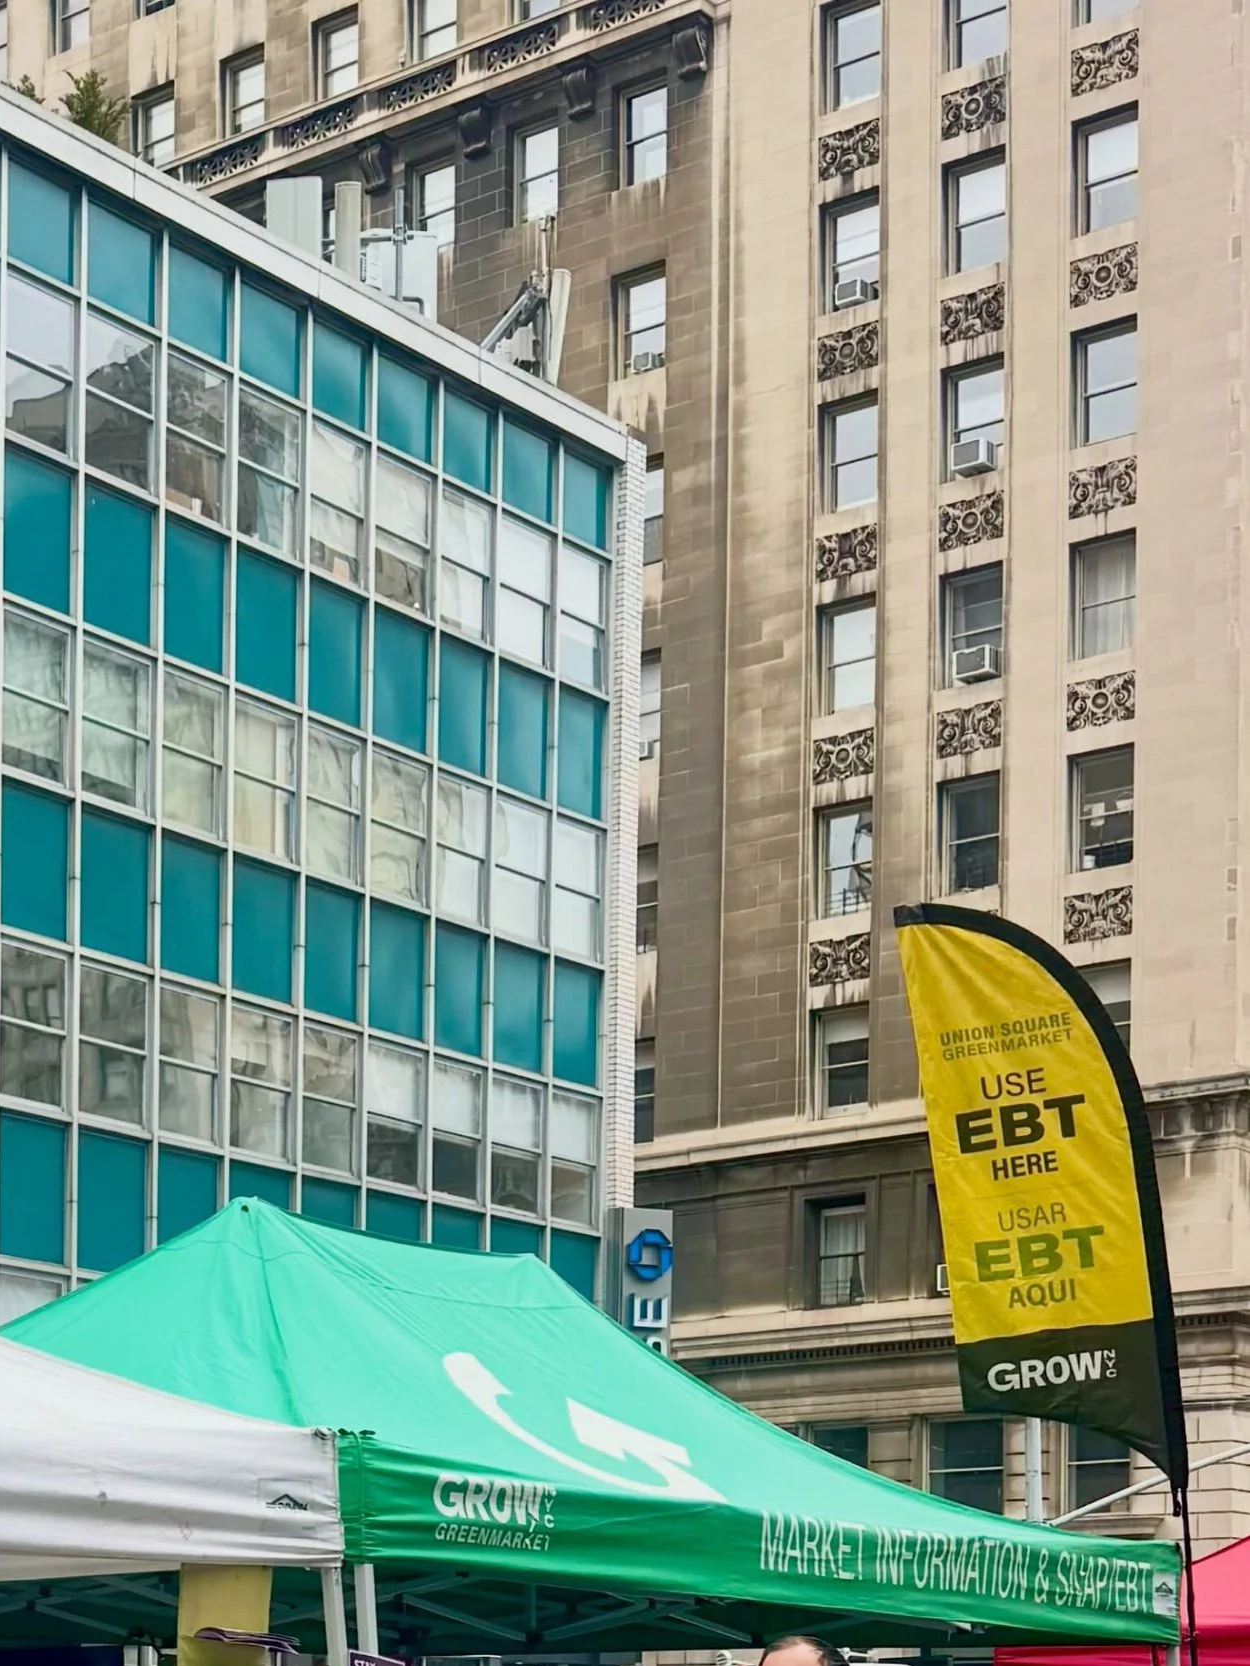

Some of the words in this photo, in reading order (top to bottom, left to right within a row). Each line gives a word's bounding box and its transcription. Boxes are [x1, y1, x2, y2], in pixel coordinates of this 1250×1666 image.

[939, 1026, 997, 1048] UNION
[1000, 1011, 1072, 1041] SQUARE
[942, 1027, 1073, 1062] GREENMARKET
[979, 1067, 1047, 1101] USE
[955, 1094, 1086, 1155] EBT
[991, 1150, 1059, 1182] HERE
[997, 1201, 1067, 1233] USAR
[974, 1225, 1105, 1283] EBT
[1007, 1278, 1078, 1310] AQUI
[987, 1350, 1103, 1393] GROW
[432, 1472, 543, 1527] GROW
[434, 1522, 551, 1552] GREENMARKET
[759, 1510, 866, 1581] MARKET
[874, 1524, 1031, 1601] INFORMATION
[1034, 1548, 1050, 1604] &
[1053, 1550, 1152, 1614] SNAP/EBT
